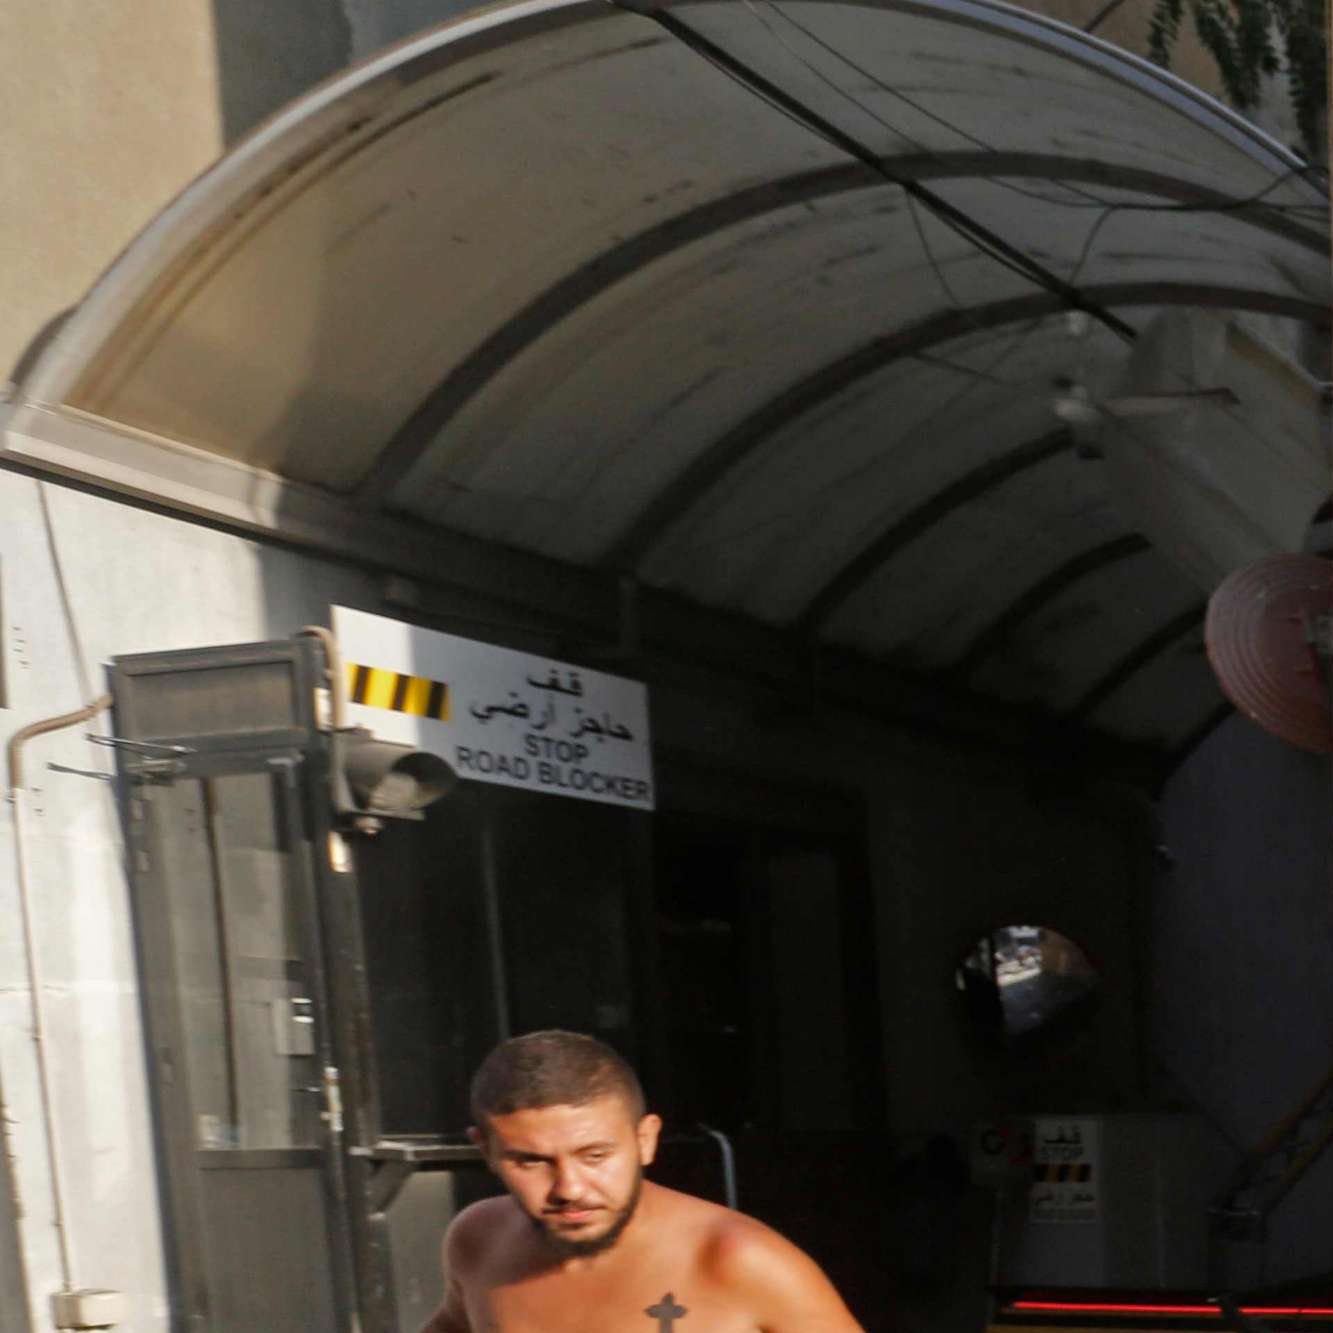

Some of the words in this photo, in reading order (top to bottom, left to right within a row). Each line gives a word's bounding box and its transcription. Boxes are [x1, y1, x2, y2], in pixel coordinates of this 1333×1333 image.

[526, 668, 584, 697] قف
[570, 706, 634, 742] حاجز
[524, 732, 590, 766] STOP
[456, 745, 531, 781] ROAD
[538, 760, 651, 801] BLOCKER
